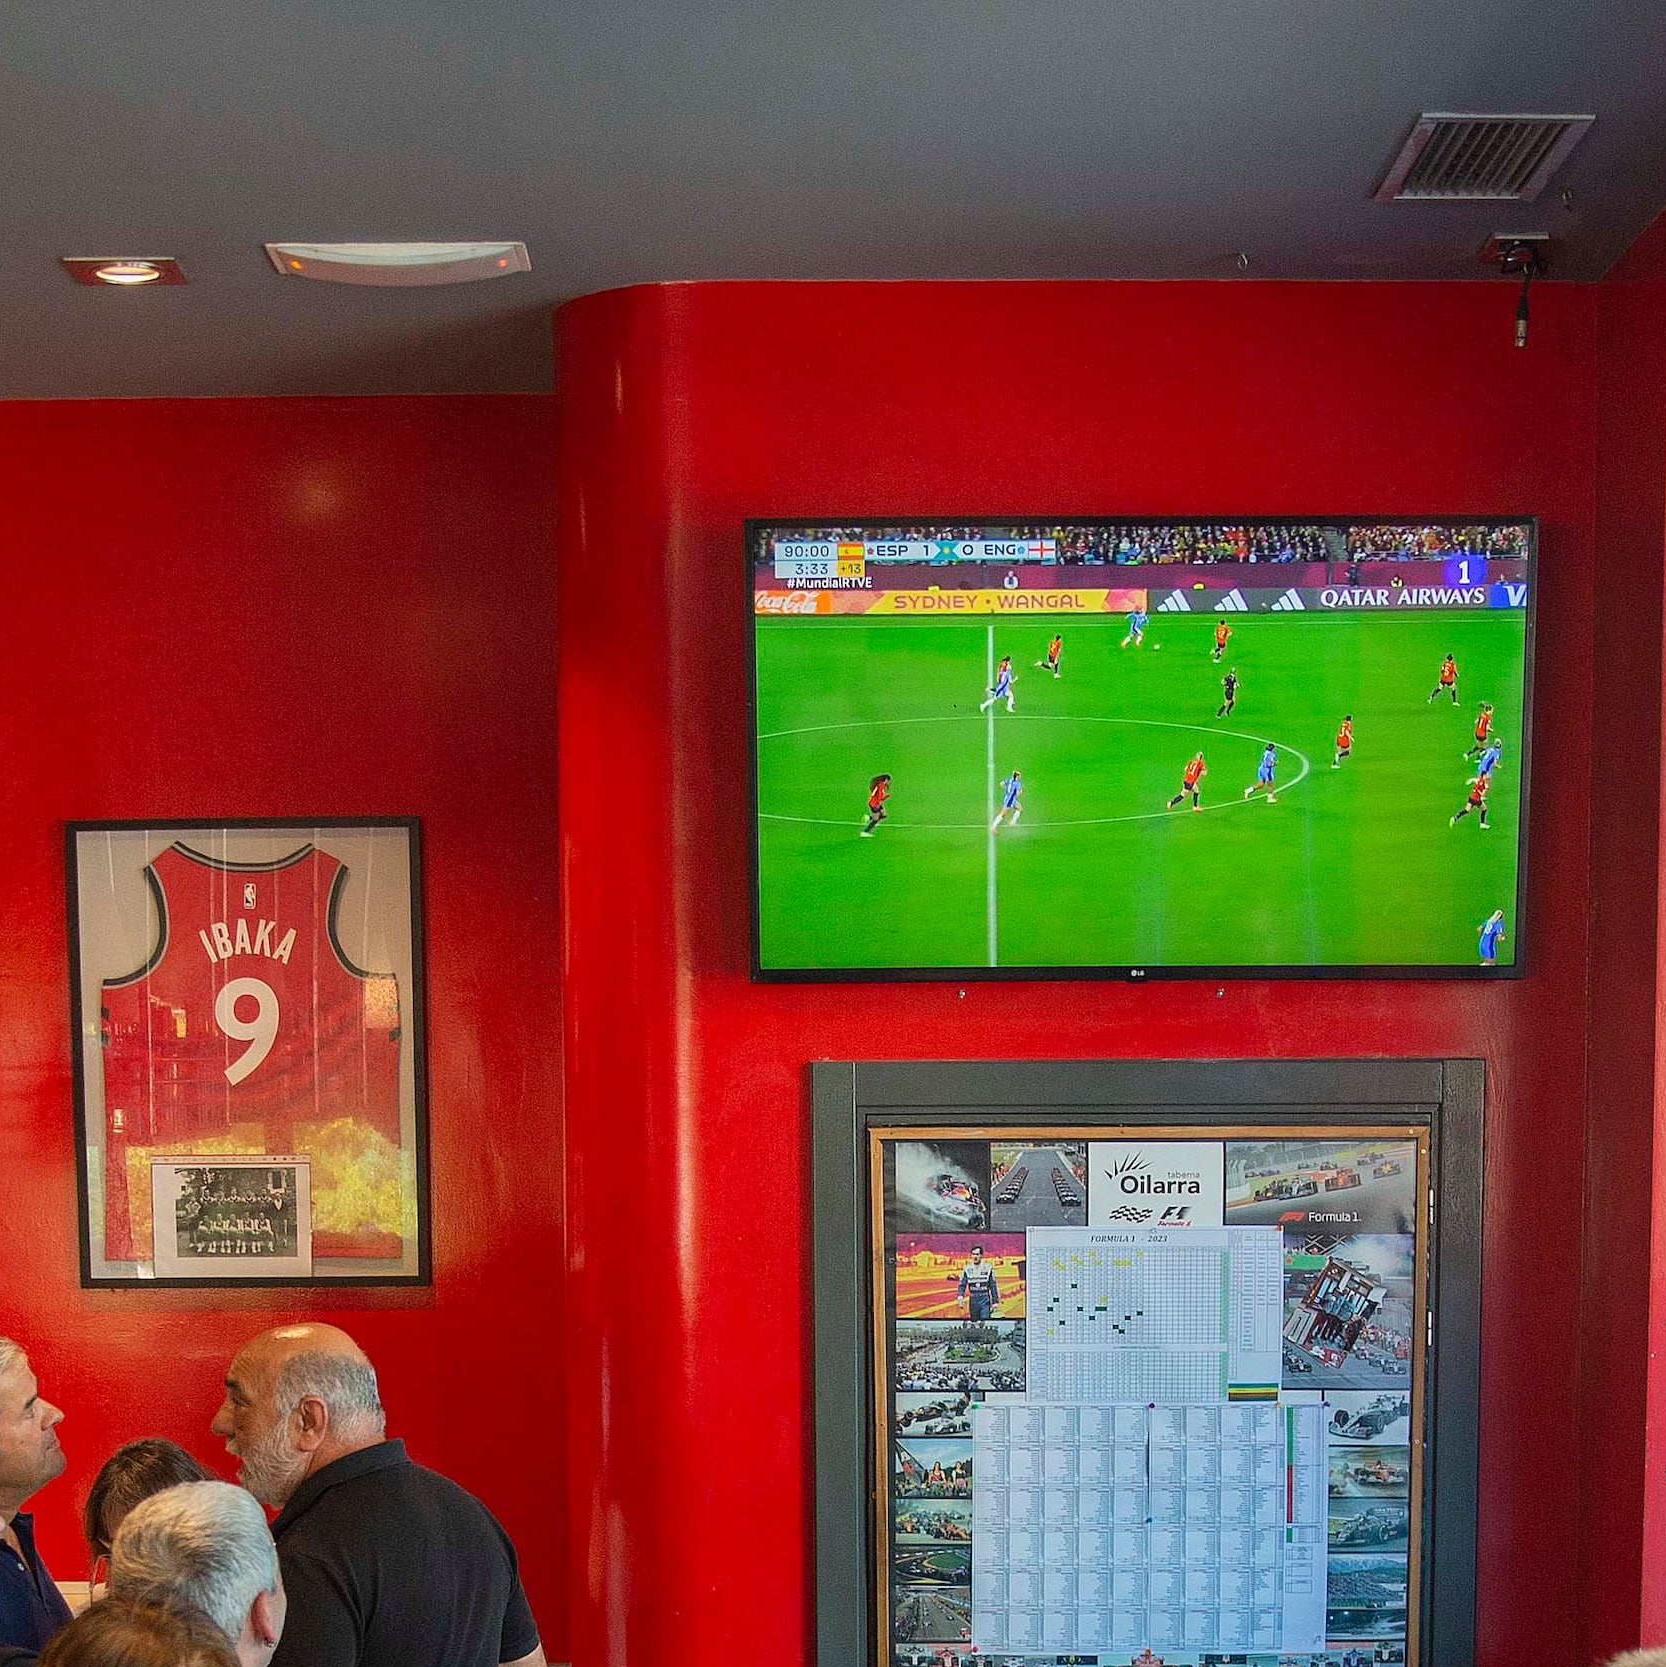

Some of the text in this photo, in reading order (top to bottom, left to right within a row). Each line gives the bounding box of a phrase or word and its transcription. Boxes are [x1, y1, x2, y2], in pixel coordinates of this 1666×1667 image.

[784, 545, 830, 558] 90:00
[876, 545, 908, 556] ESP
[923, 545, 930, 556] 1
[984, 544, 1016, 556] ENG
[795, 563, 862, 575] 3:33 +13
[1458, 560, 1471, 585] 1
[787, 577, 873, 589] #MundialRTVE
[894, 594, 1085, 609] SYDNEY WANGAL
[1320, 587, 1485, 609] QATAR AIRWAYS
[199, 918, 297, 965] IBAKA
[215, 977, 280, 1086] 9
[1167, 1170, 1201, 1179] taberna
[1120, 1175, 1201, 1194] Oilarra
[1308, 1211, 1351, 1222] Formula
